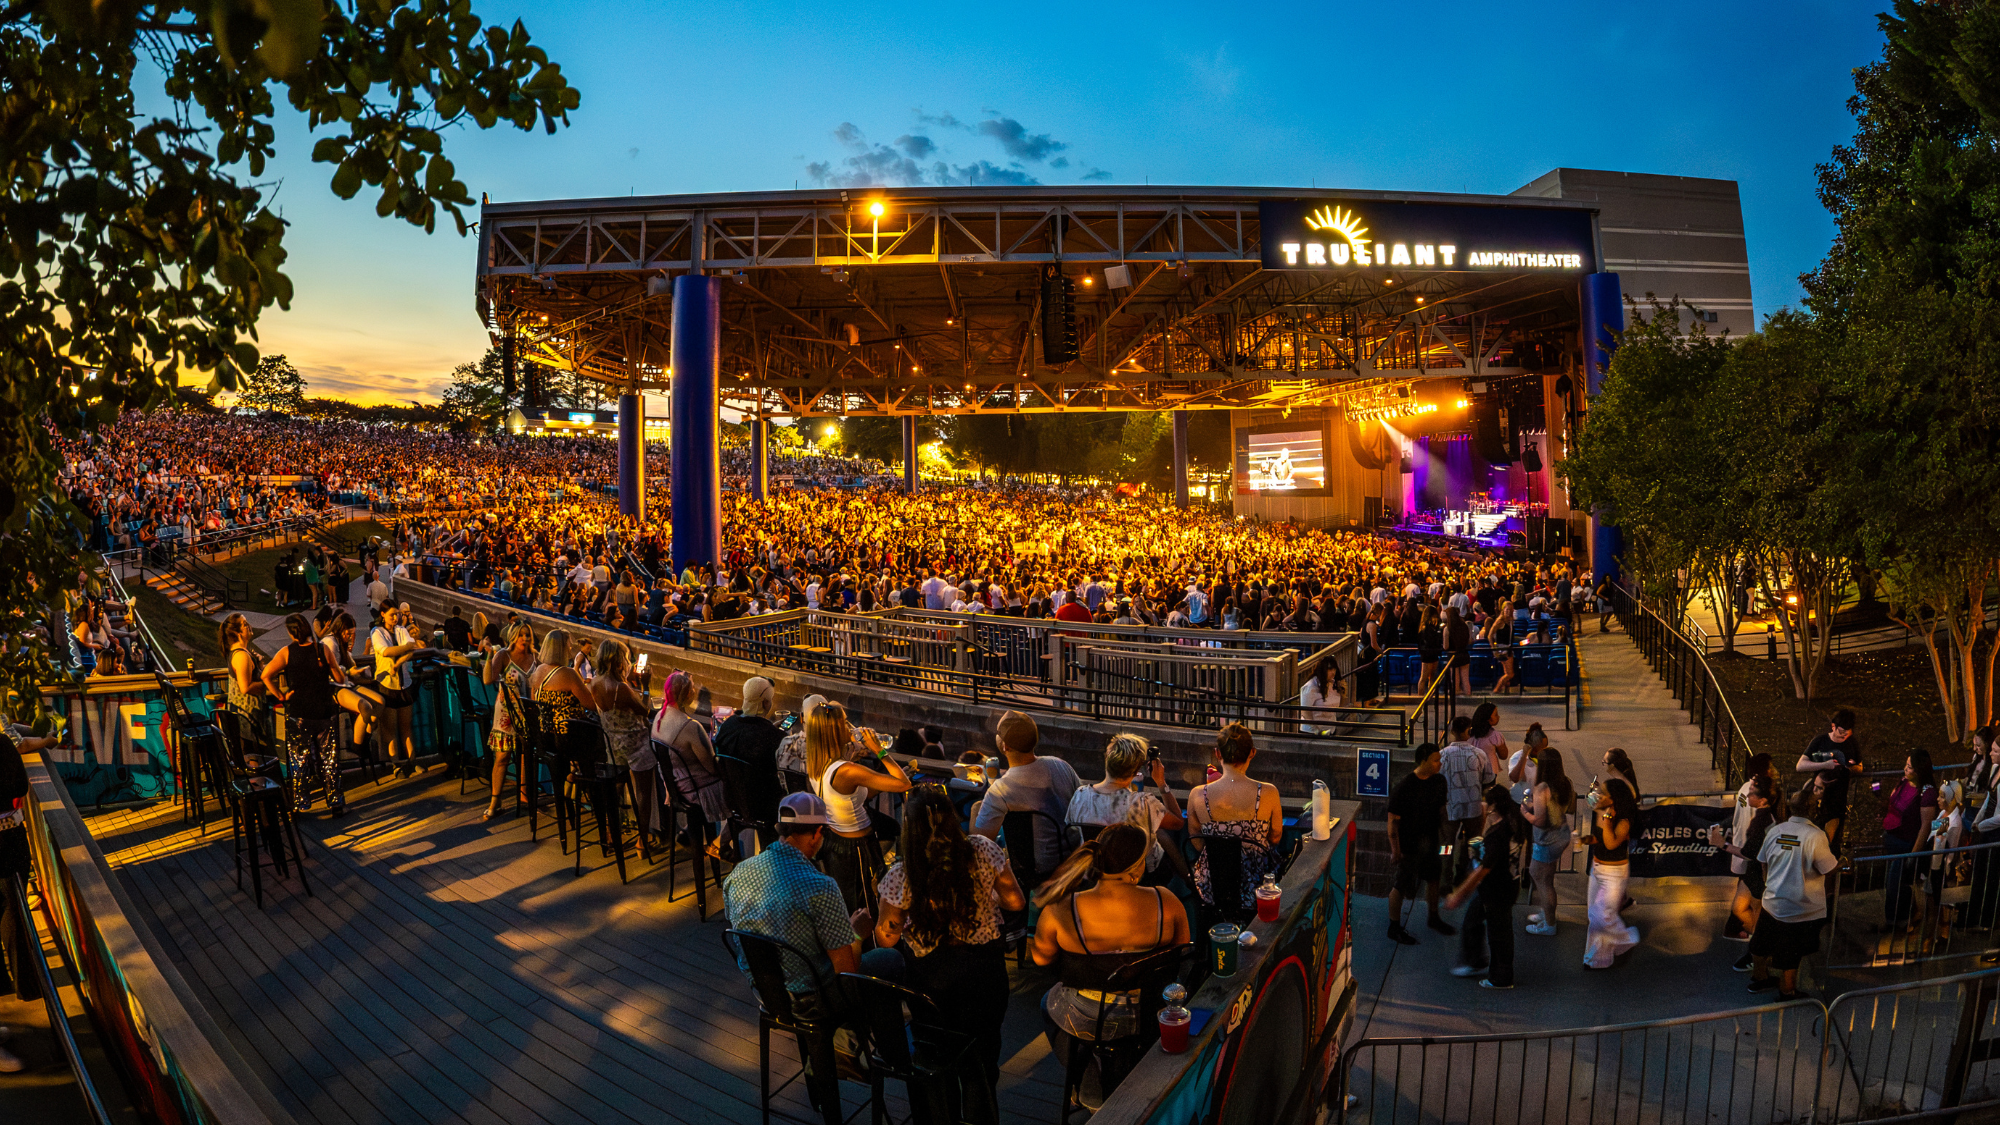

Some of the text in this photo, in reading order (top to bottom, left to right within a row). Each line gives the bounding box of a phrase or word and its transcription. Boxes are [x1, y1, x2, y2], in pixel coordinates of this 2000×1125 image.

[1282, 242, 1582, 268] TRULIANT AMPHITHEATER
[1366, 763, 1380, 780] 4
[1641, 827, 1692, 840] AISLES
[1648, 842, 1718, 857] Standing
